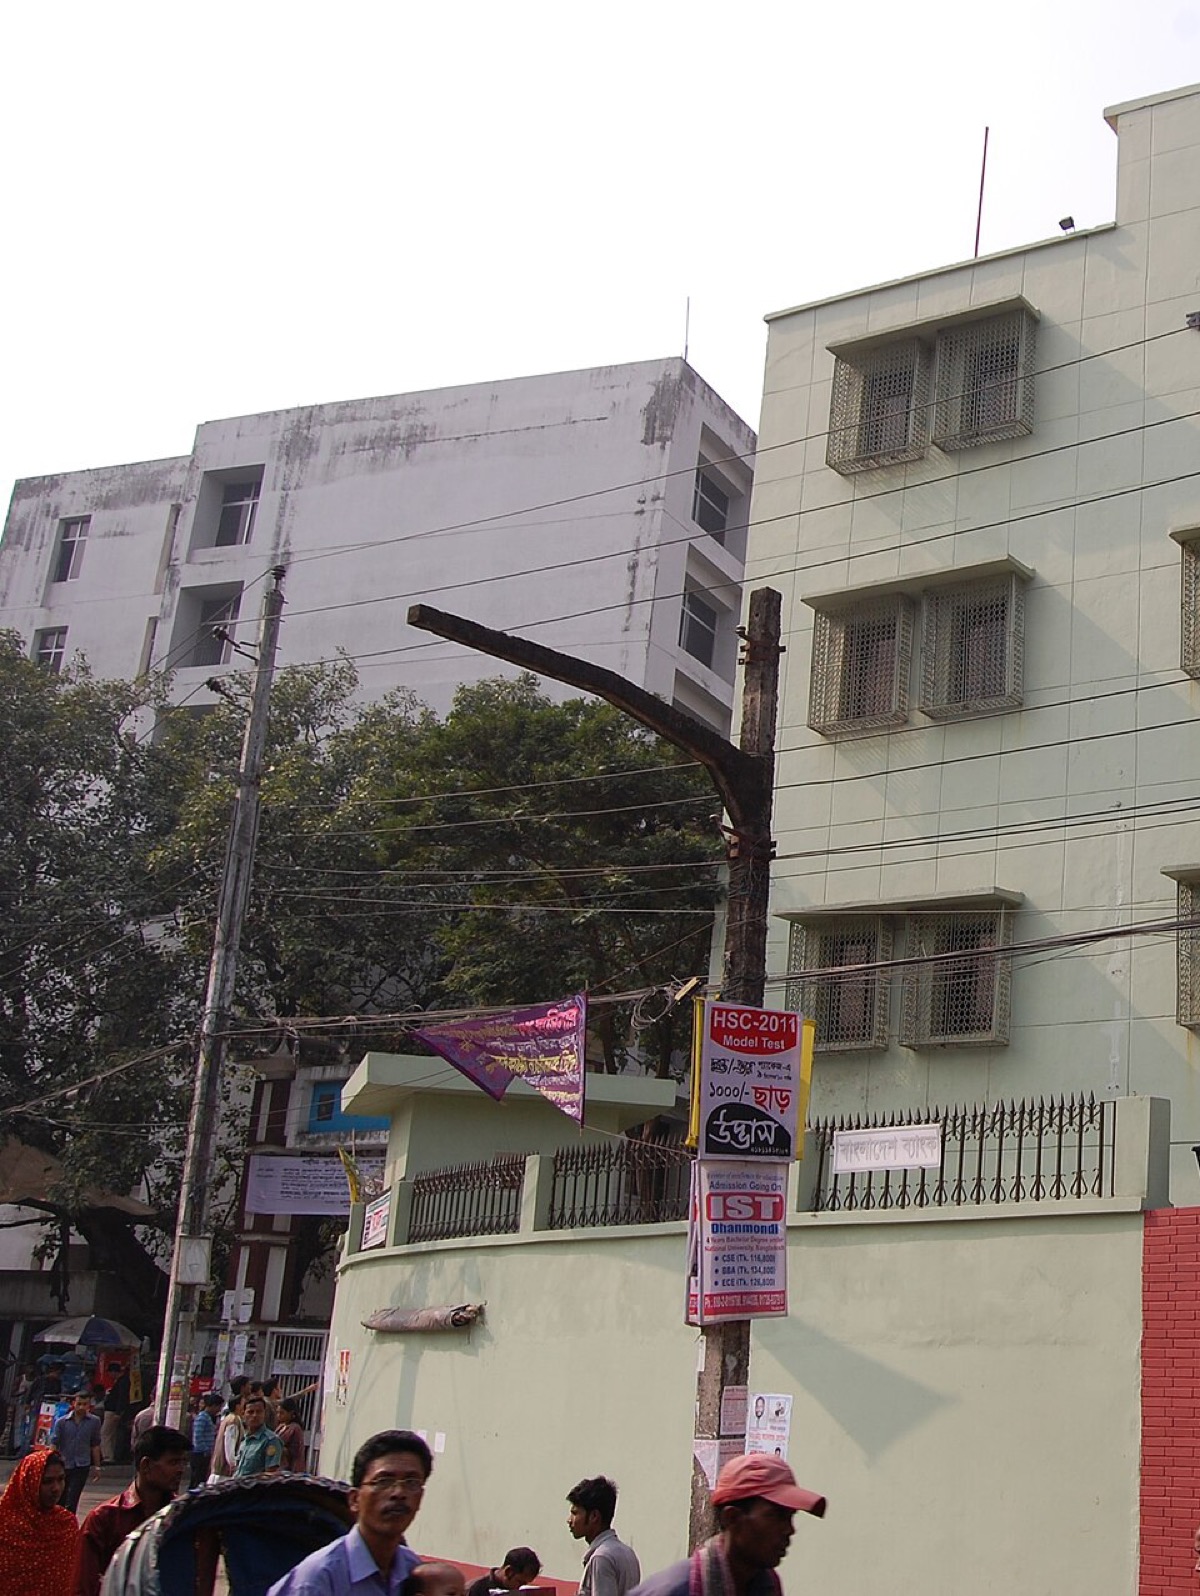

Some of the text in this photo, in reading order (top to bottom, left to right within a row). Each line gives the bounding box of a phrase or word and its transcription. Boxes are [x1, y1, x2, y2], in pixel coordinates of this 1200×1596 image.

[713, 1010, 797, 1033] HSC-2011
[723, 1034, 785, 1050] Model Test
[709, 1082, 792, 1115] ১০০০/- ছাড়
[709, 1109, 780, 1149] উদ্ভাস
[838, 1135, 938, 1164] বাংলাদেশ ব্যাংক
[709, 1181, 782, 1192] Admission Going On
[710, 1195, 780, 1219] IST
[711, 1223, 779, 1234] Dhanmondi
[722, 1254, 735, 1262] CSE
[722, 1278, 735, 1286] ECE
